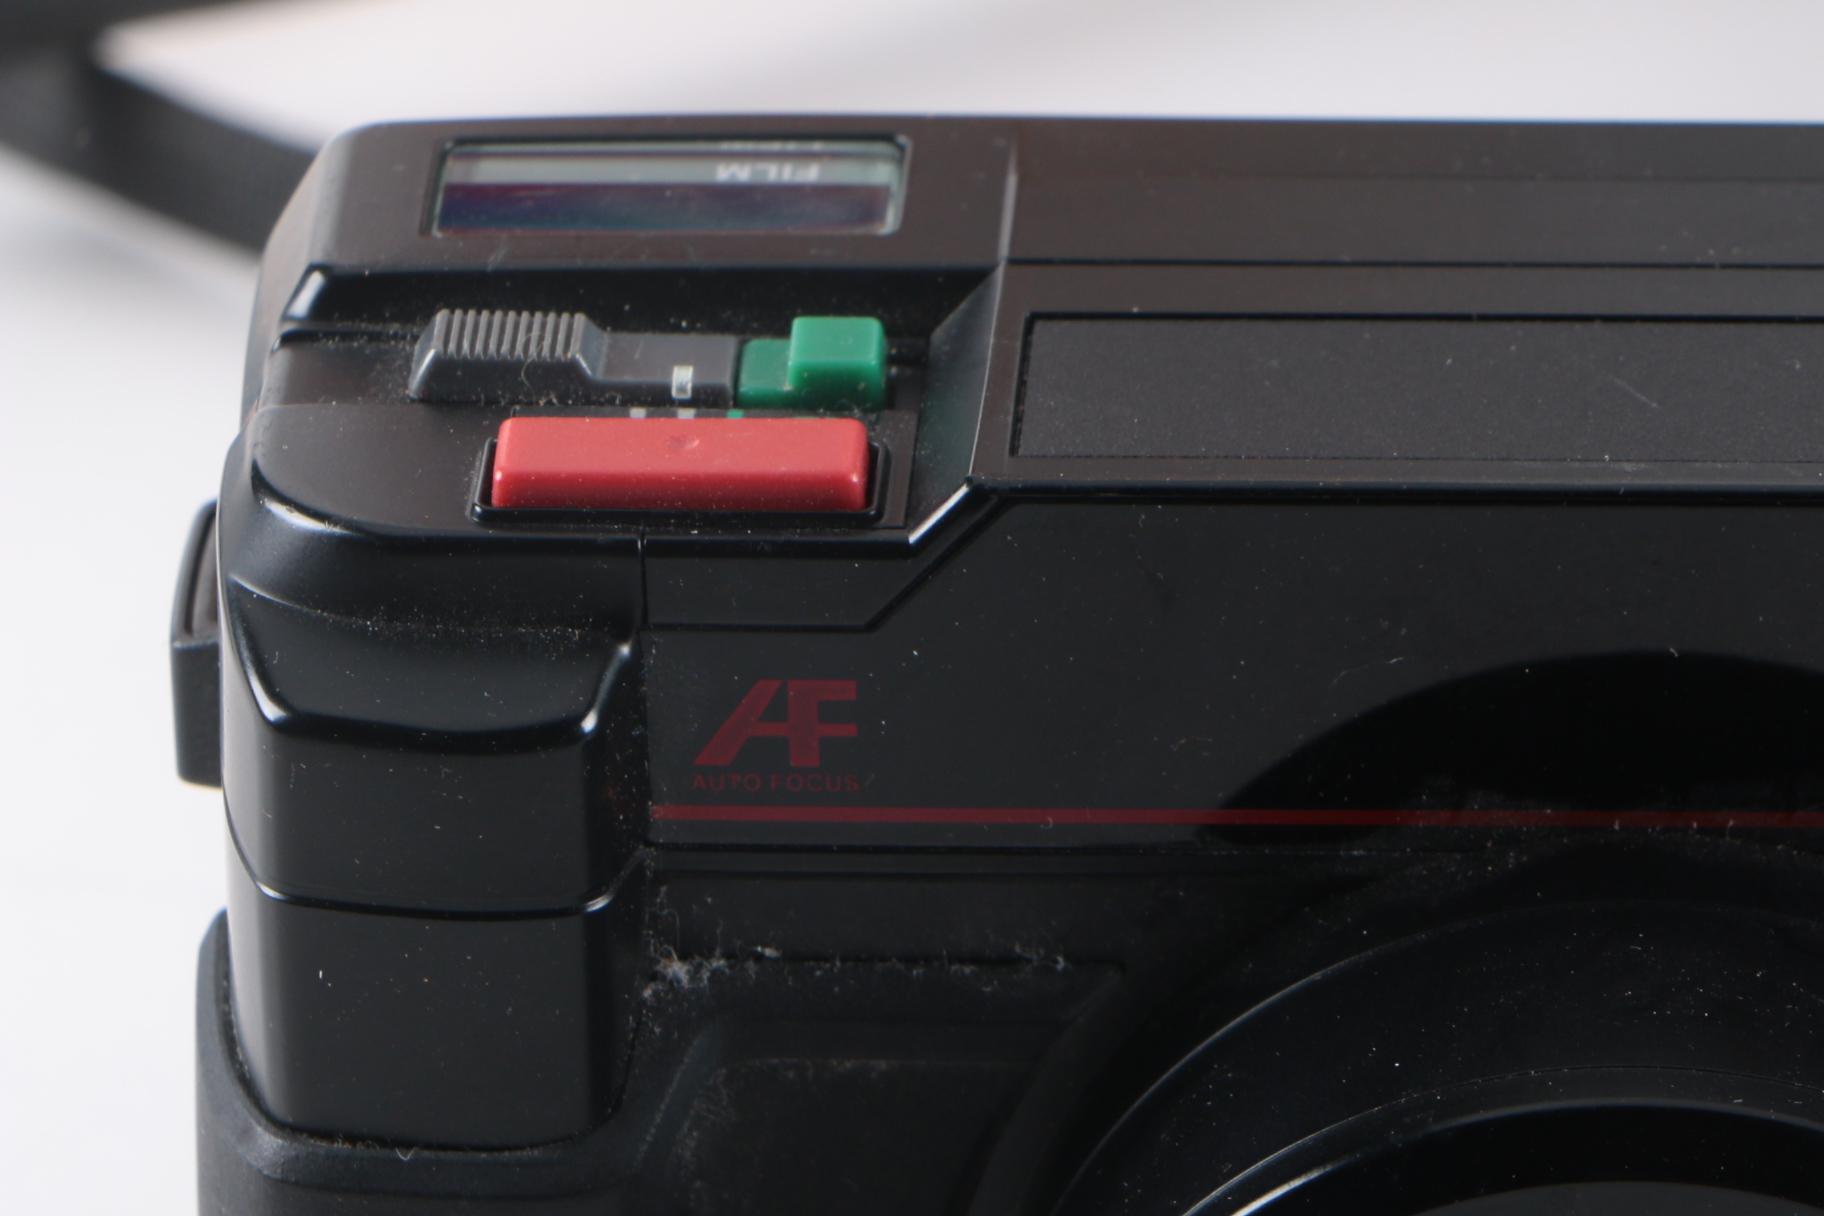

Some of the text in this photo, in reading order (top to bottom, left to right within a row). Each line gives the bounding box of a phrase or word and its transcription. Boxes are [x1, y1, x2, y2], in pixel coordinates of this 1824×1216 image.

[715, 161, 820, 183] FILM
[692, 679, 859, 768] AF
[690, 771, 860, 794] AUTO FOCUS
